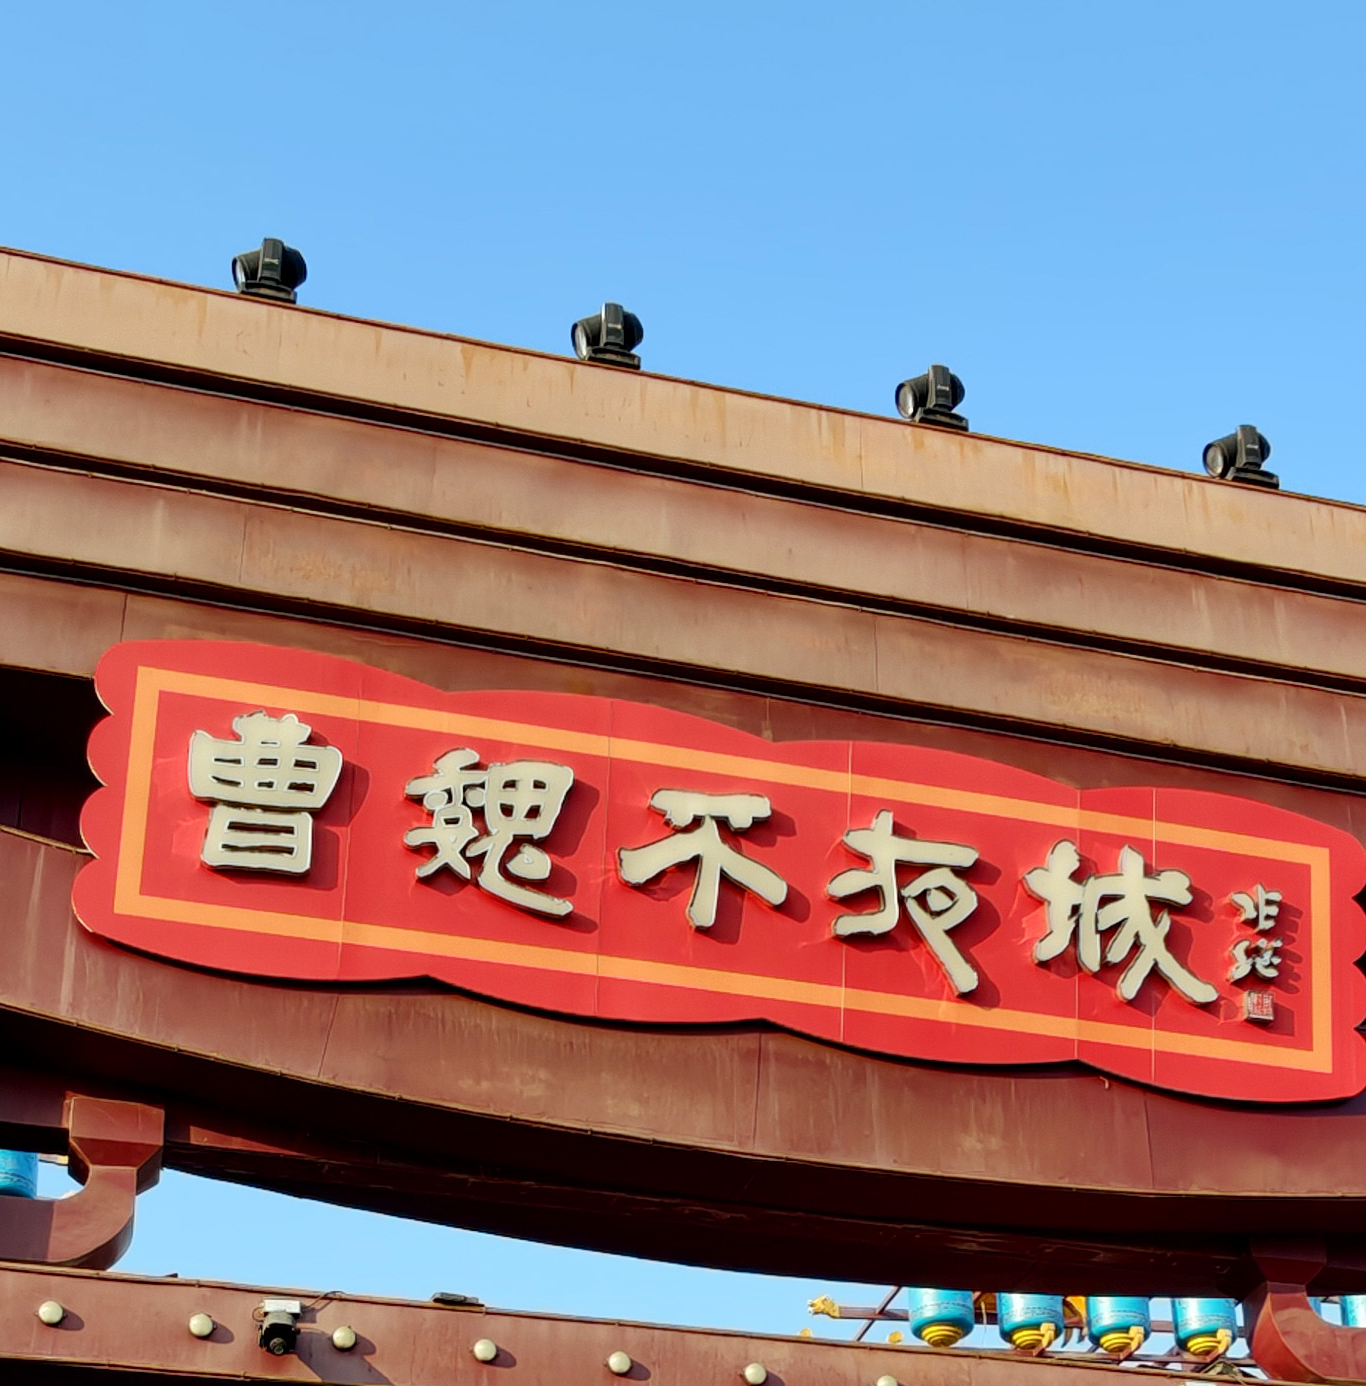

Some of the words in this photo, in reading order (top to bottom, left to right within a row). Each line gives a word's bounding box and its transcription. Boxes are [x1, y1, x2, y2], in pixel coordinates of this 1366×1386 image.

[187, 711, 1220, 1004] 曹魏不夜城
